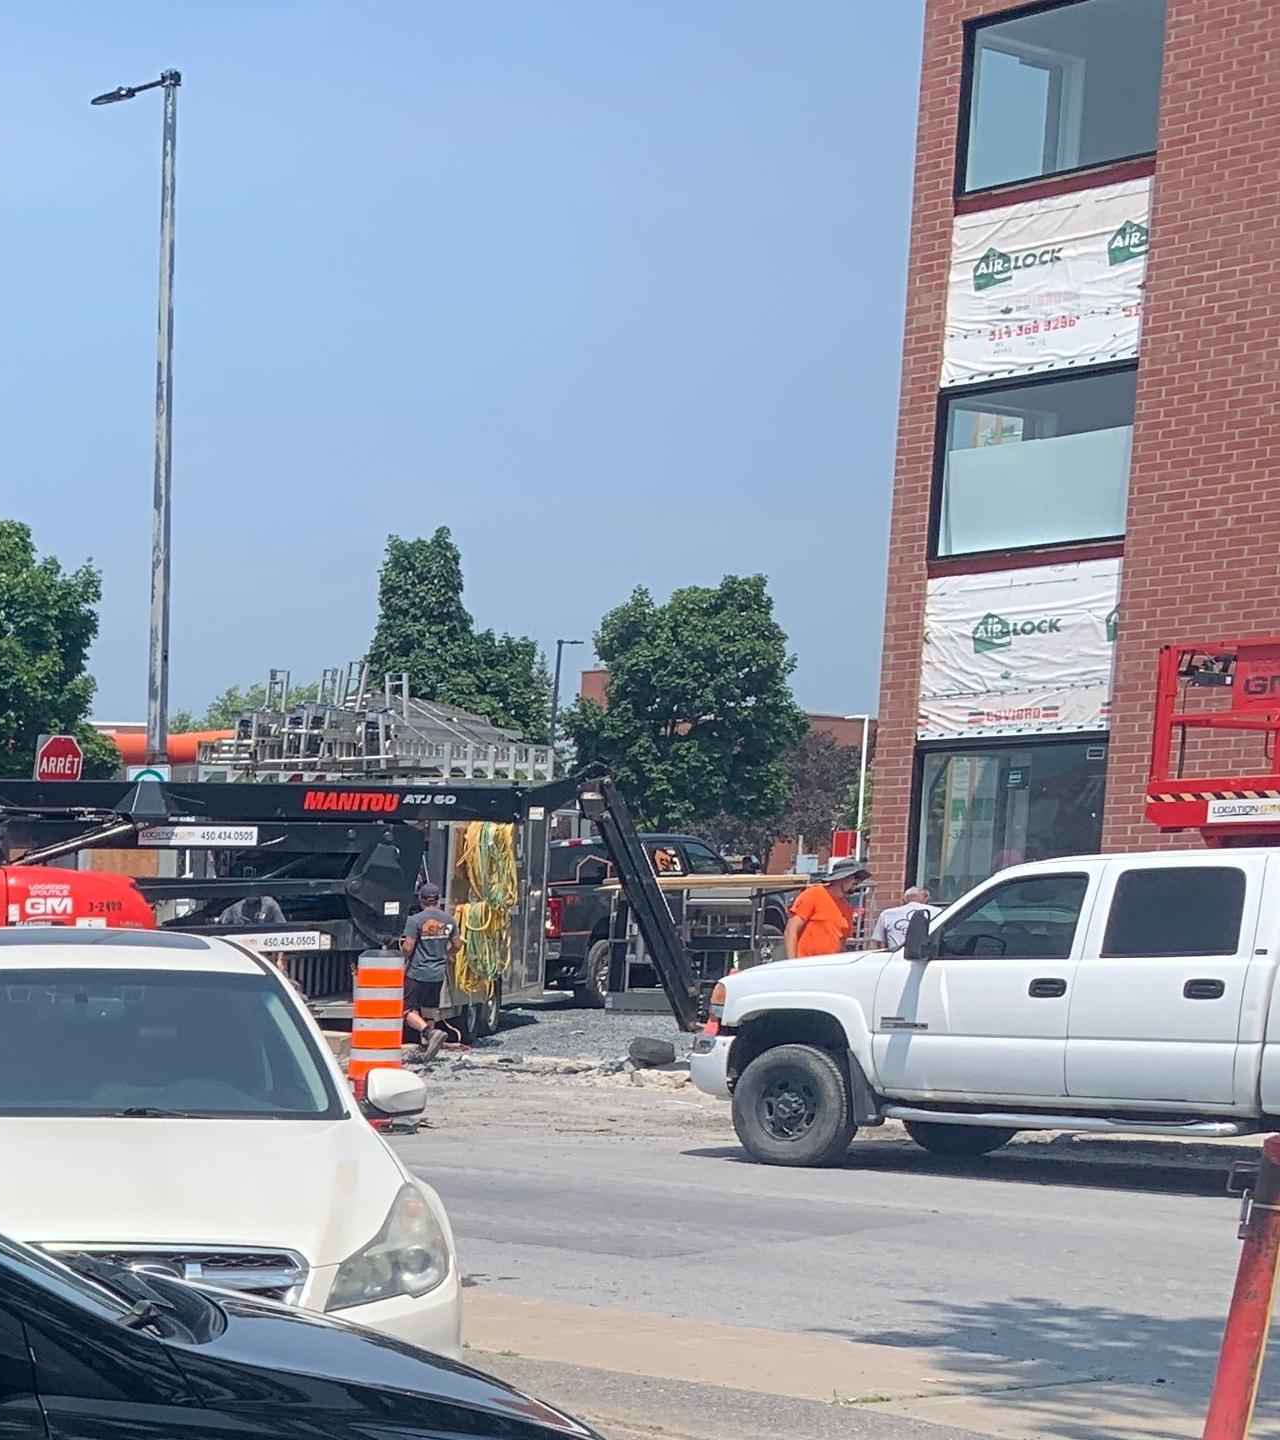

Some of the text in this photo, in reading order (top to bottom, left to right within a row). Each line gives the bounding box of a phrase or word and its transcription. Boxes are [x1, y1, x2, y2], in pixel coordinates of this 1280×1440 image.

[976, 247, 1064, 276] AIR-LOCK
[39, 754, 80, 774] ARRÊT
[303, 791, 401, 812] MANITOU
[402, 794, 432, 804] ATJ
[1212, 805, 1259, 815] LOCATION
[200, 830, 254, 841] 450.434.0505
[24, 897, 74, 914] GM
[263, 935, 316, 948] 450.434.0505
